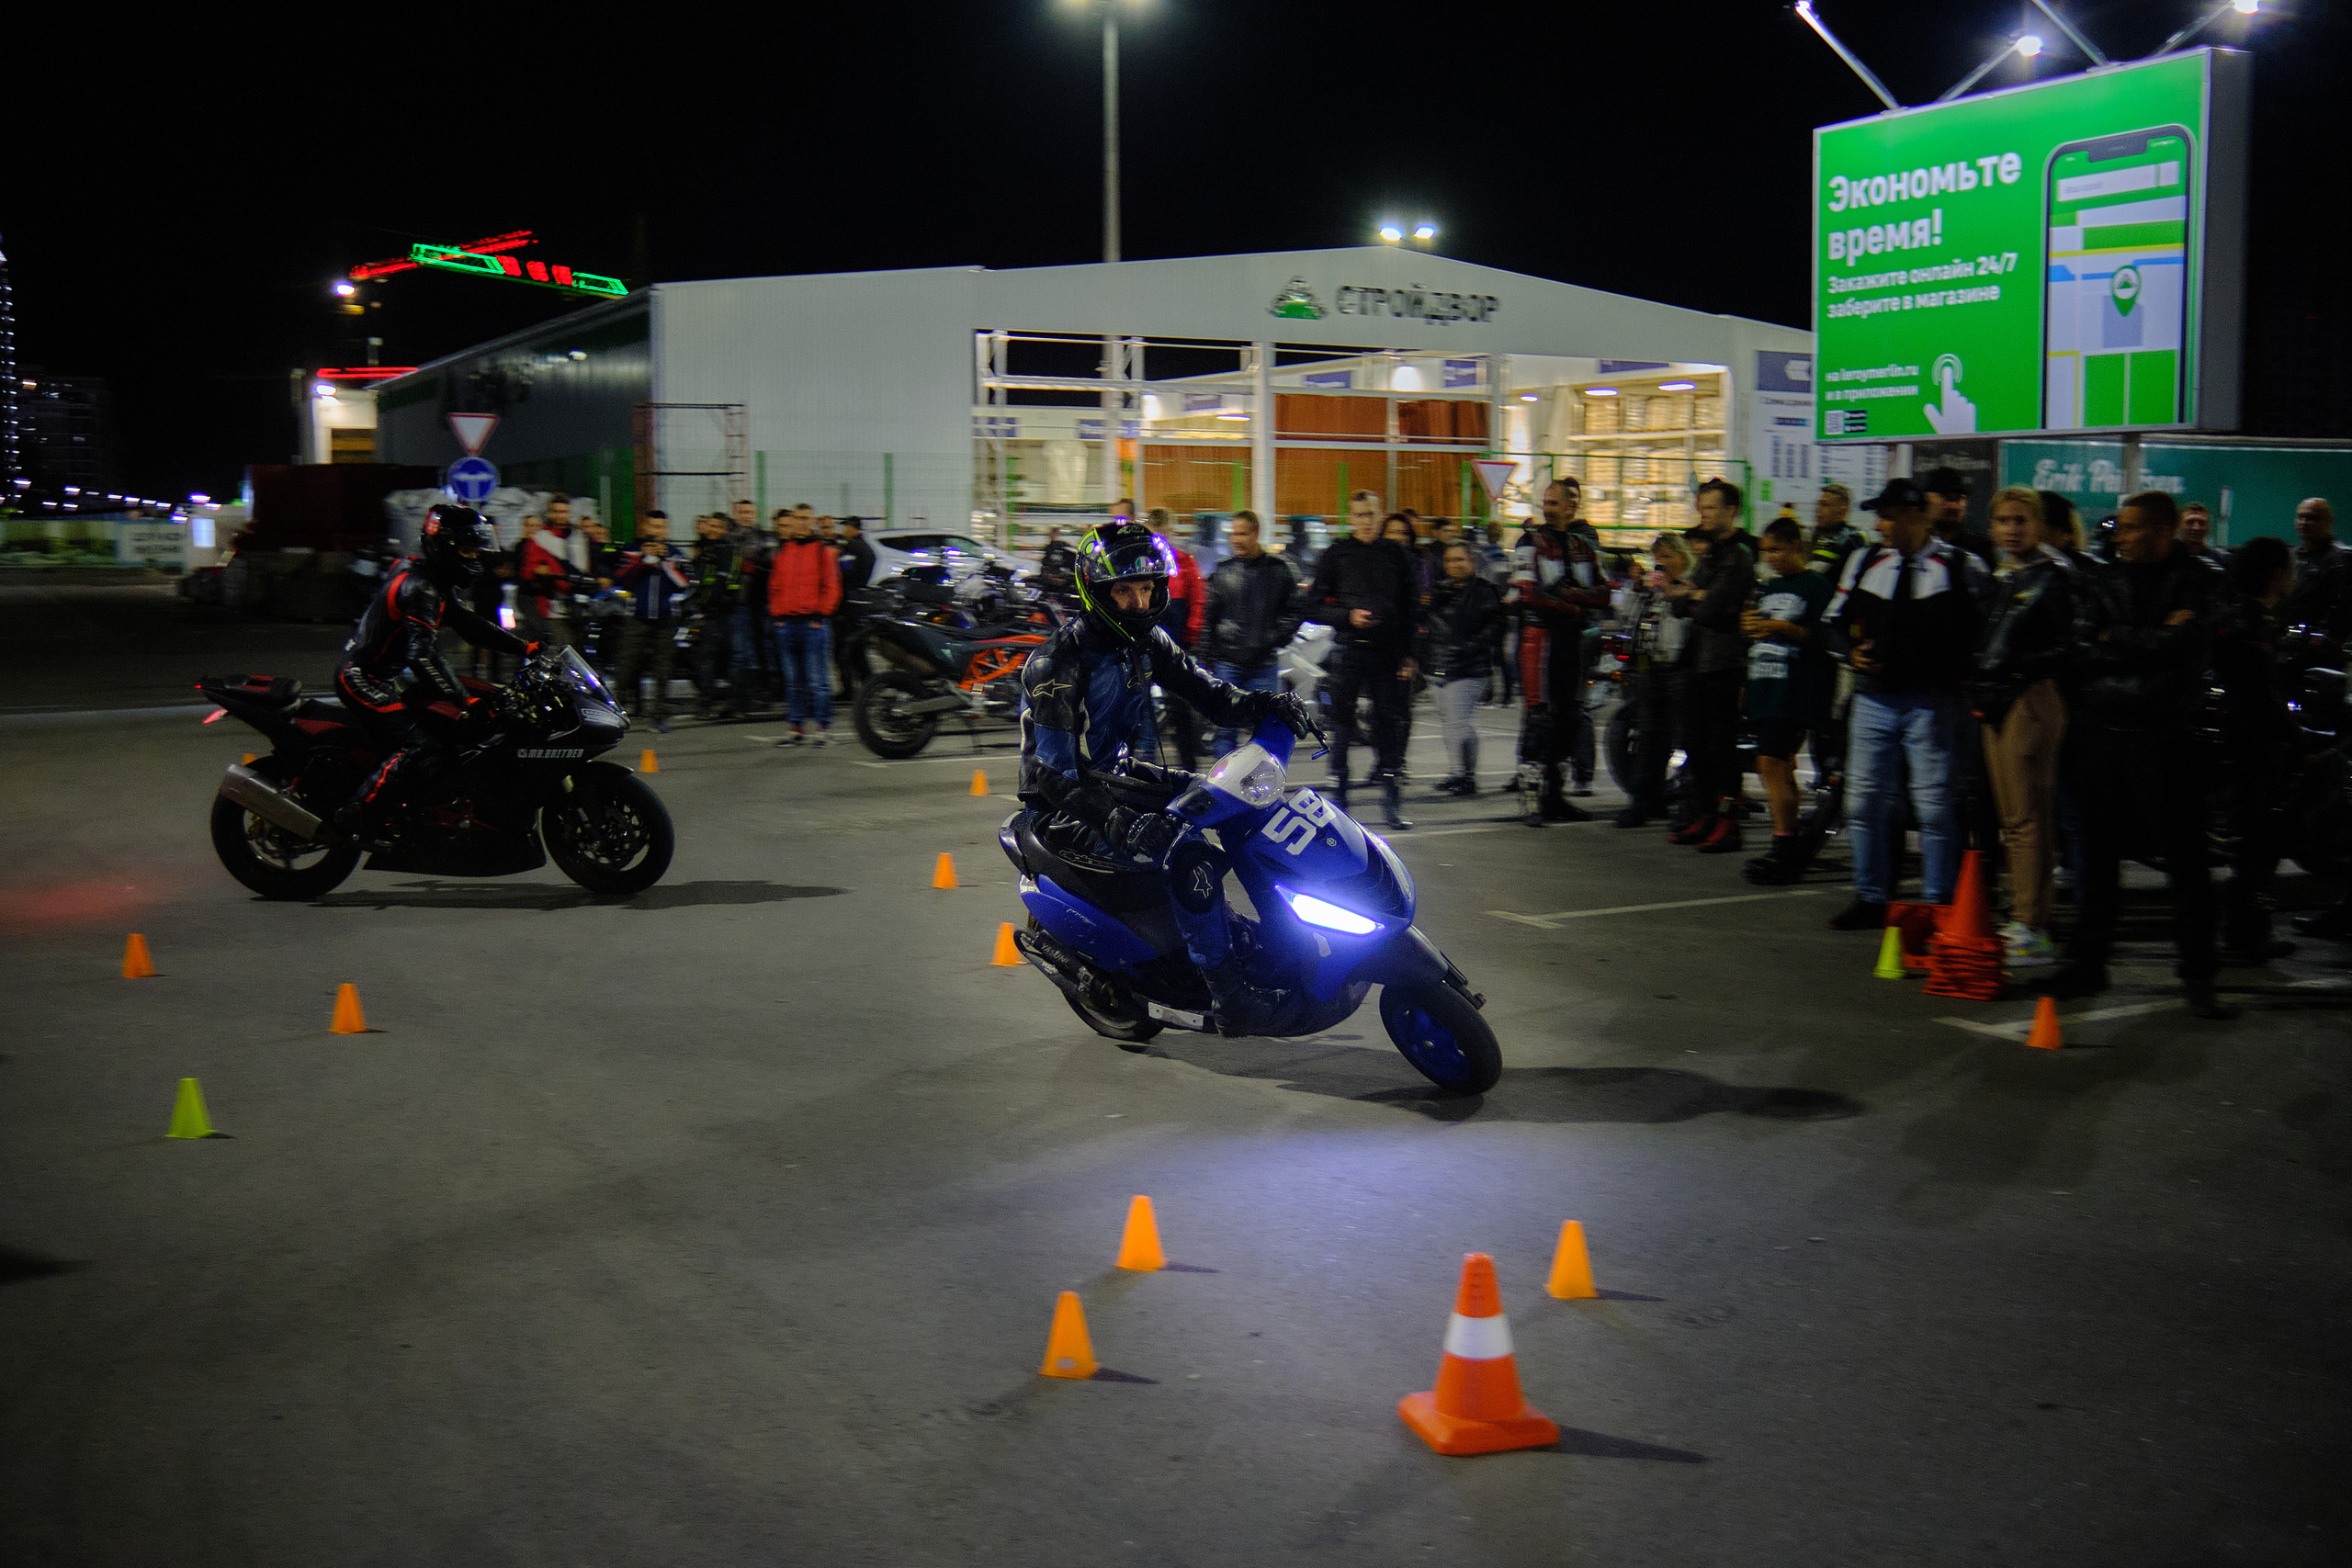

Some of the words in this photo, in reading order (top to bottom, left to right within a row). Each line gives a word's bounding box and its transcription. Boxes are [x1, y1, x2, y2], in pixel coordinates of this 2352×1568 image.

[1827, 152, 2022, 212] Экономьте
[1827, 209, 1943, 266] время!
[1827, 271, 1908, 294] Закажите
[1908, 258, 1975, 284] онлайн
[1975, 252, 2018, 276] 24/7
[1336, 283, 1500, 327] СТРОЙДВОР
[1826, 295, 1901, 319] заберите
[1901, 295, 1915, 310] в
[1915, 285, 2001, 309] магазине
[1261, 786, 1337, 856] 58
[1041, 942, 1069, 964] YASUNI
